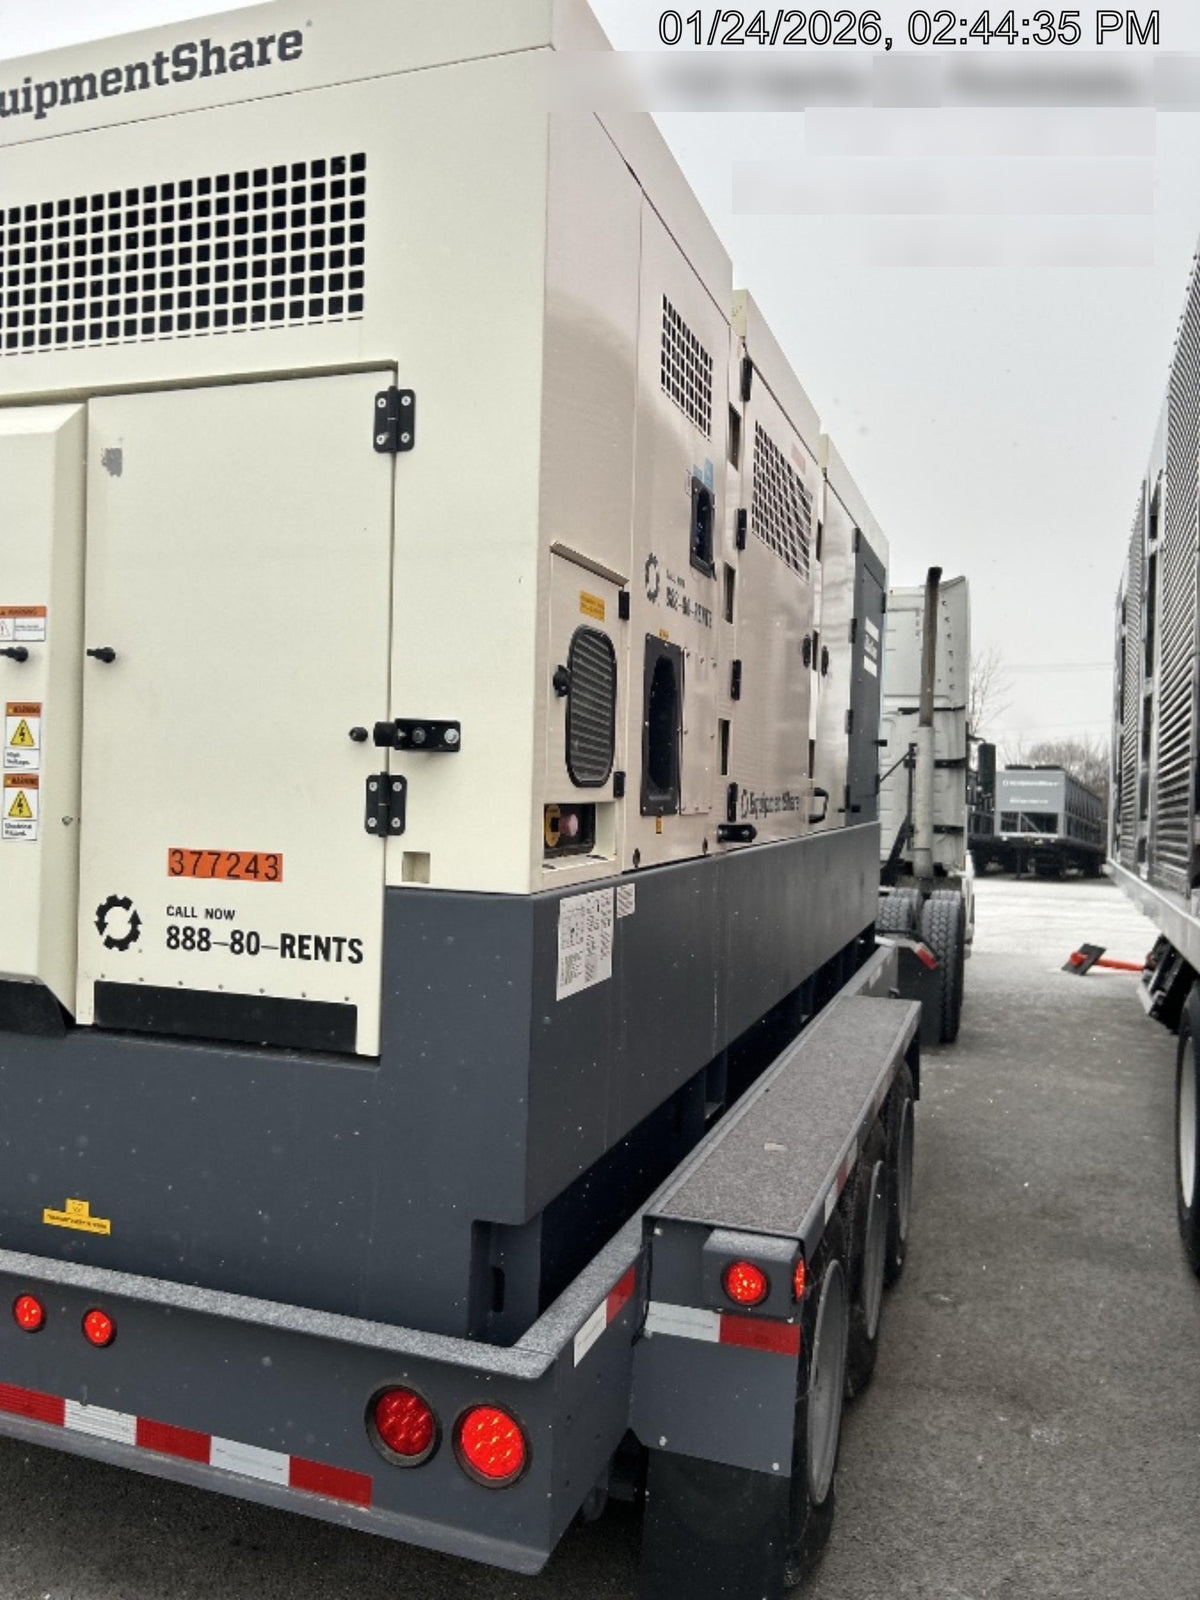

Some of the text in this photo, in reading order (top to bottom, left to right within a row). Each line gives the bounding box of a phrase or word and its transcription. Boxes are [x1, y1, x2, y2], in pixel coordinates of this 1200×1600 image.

[169, 849, 280, 881] 377243
[166, 905, 236, 921] CALL NOW
[165, 925, 364, 965] 888-80-RENTS
